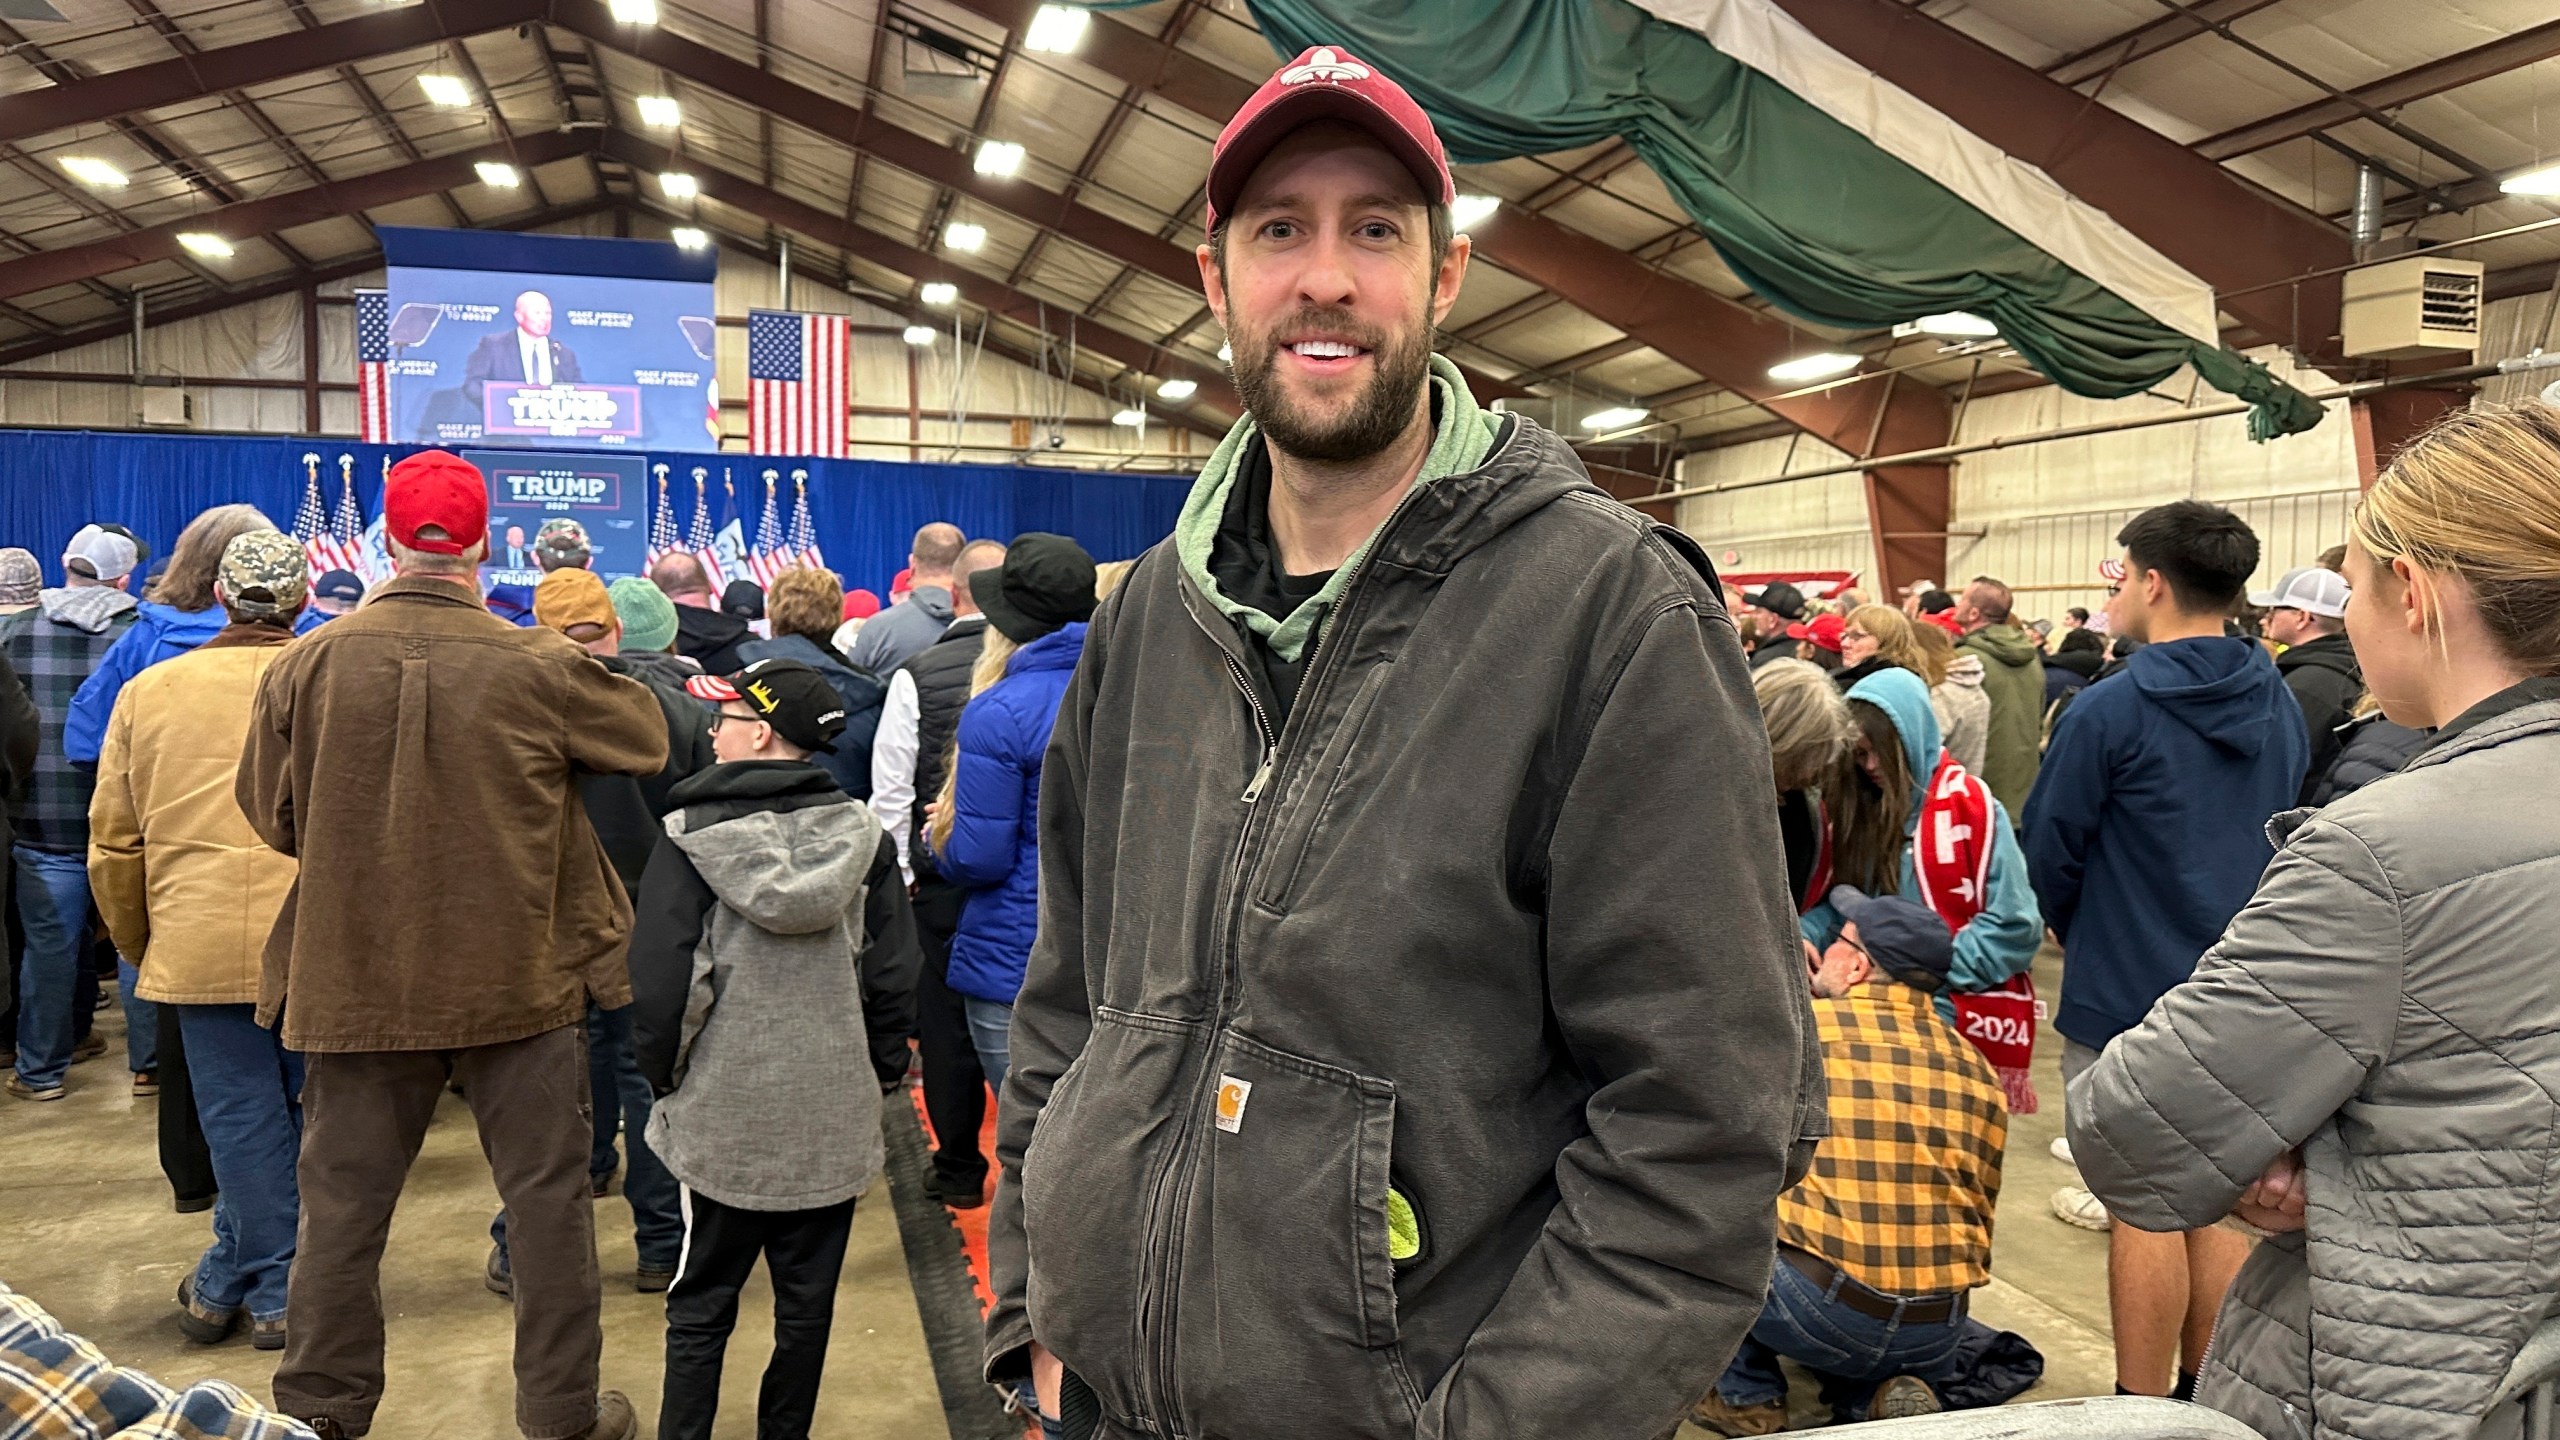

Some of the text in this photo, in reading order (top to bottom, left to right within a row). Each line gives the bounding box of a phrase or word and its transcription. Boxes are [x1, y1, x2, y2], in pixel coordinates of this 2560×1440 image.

[508, 397, 617, 420] TRUMP
[506, 475, 607, 497] TRUMP
[1965, 1010, 2030, 1047] 2024
